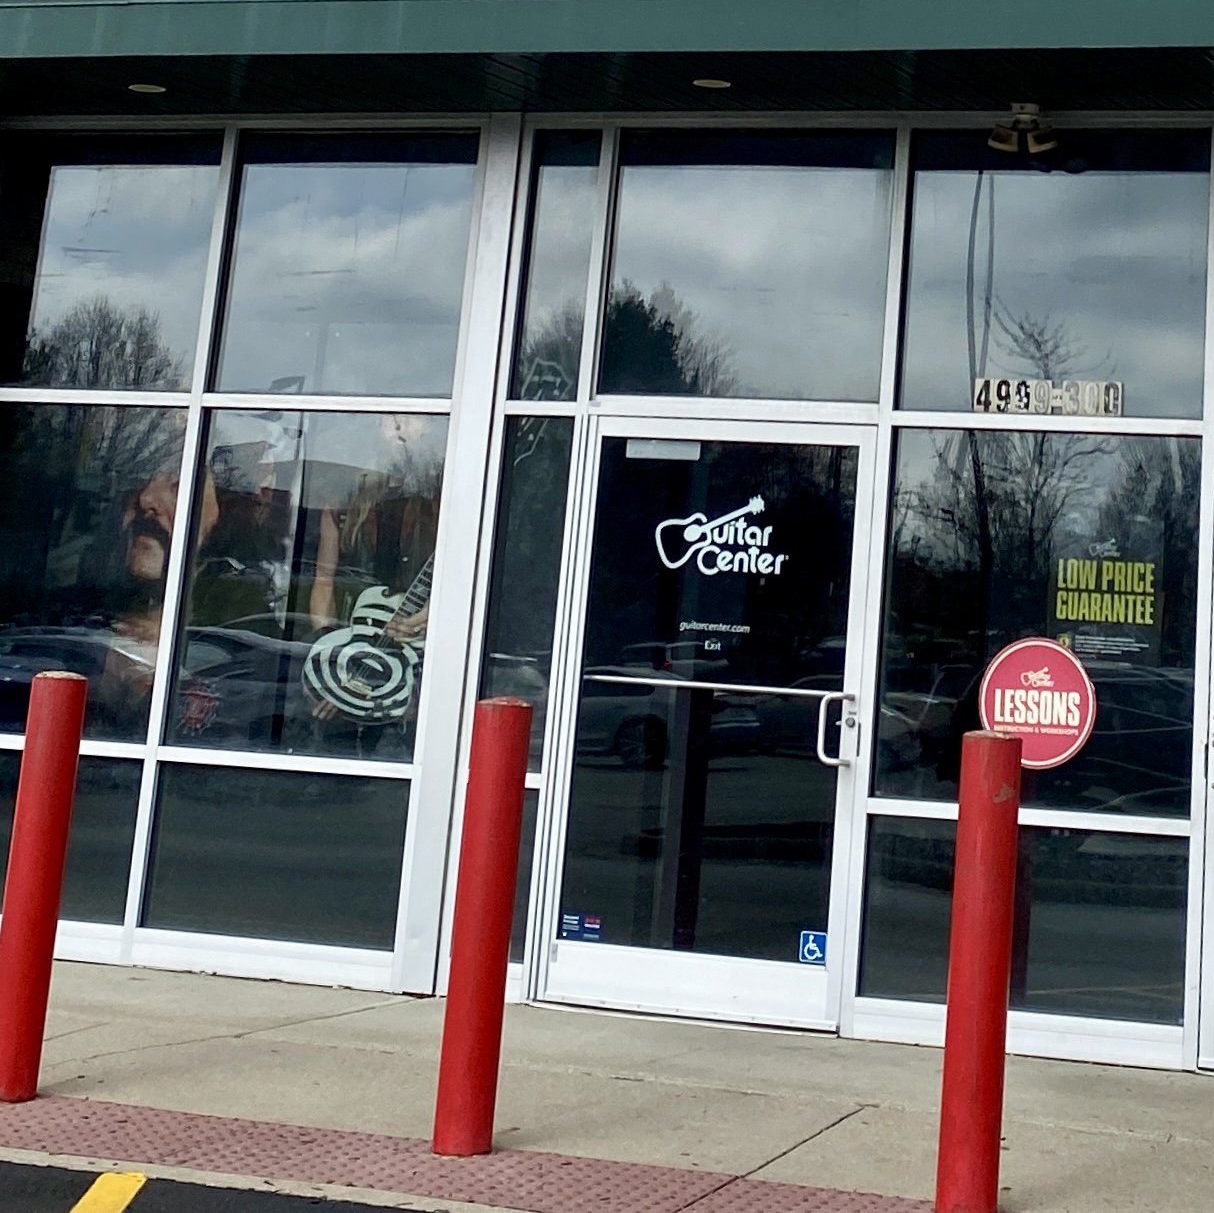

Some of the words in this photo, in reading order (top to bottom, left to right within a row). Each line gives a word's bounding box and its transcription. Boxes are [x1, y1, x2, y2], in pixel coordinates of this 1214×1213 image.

[697, 545, 786, 576] Center
[1057, 558, 1097, 590] LOW
[1102, 561, 1155, 593] PRICE
[1056, 591, 1154, 625] GUARANTEE
[679, 620, 750, 634] guitarcenter.com
[704, 640, 721, 651] Exit
[994, 688, 1081, 726] LESSONS
